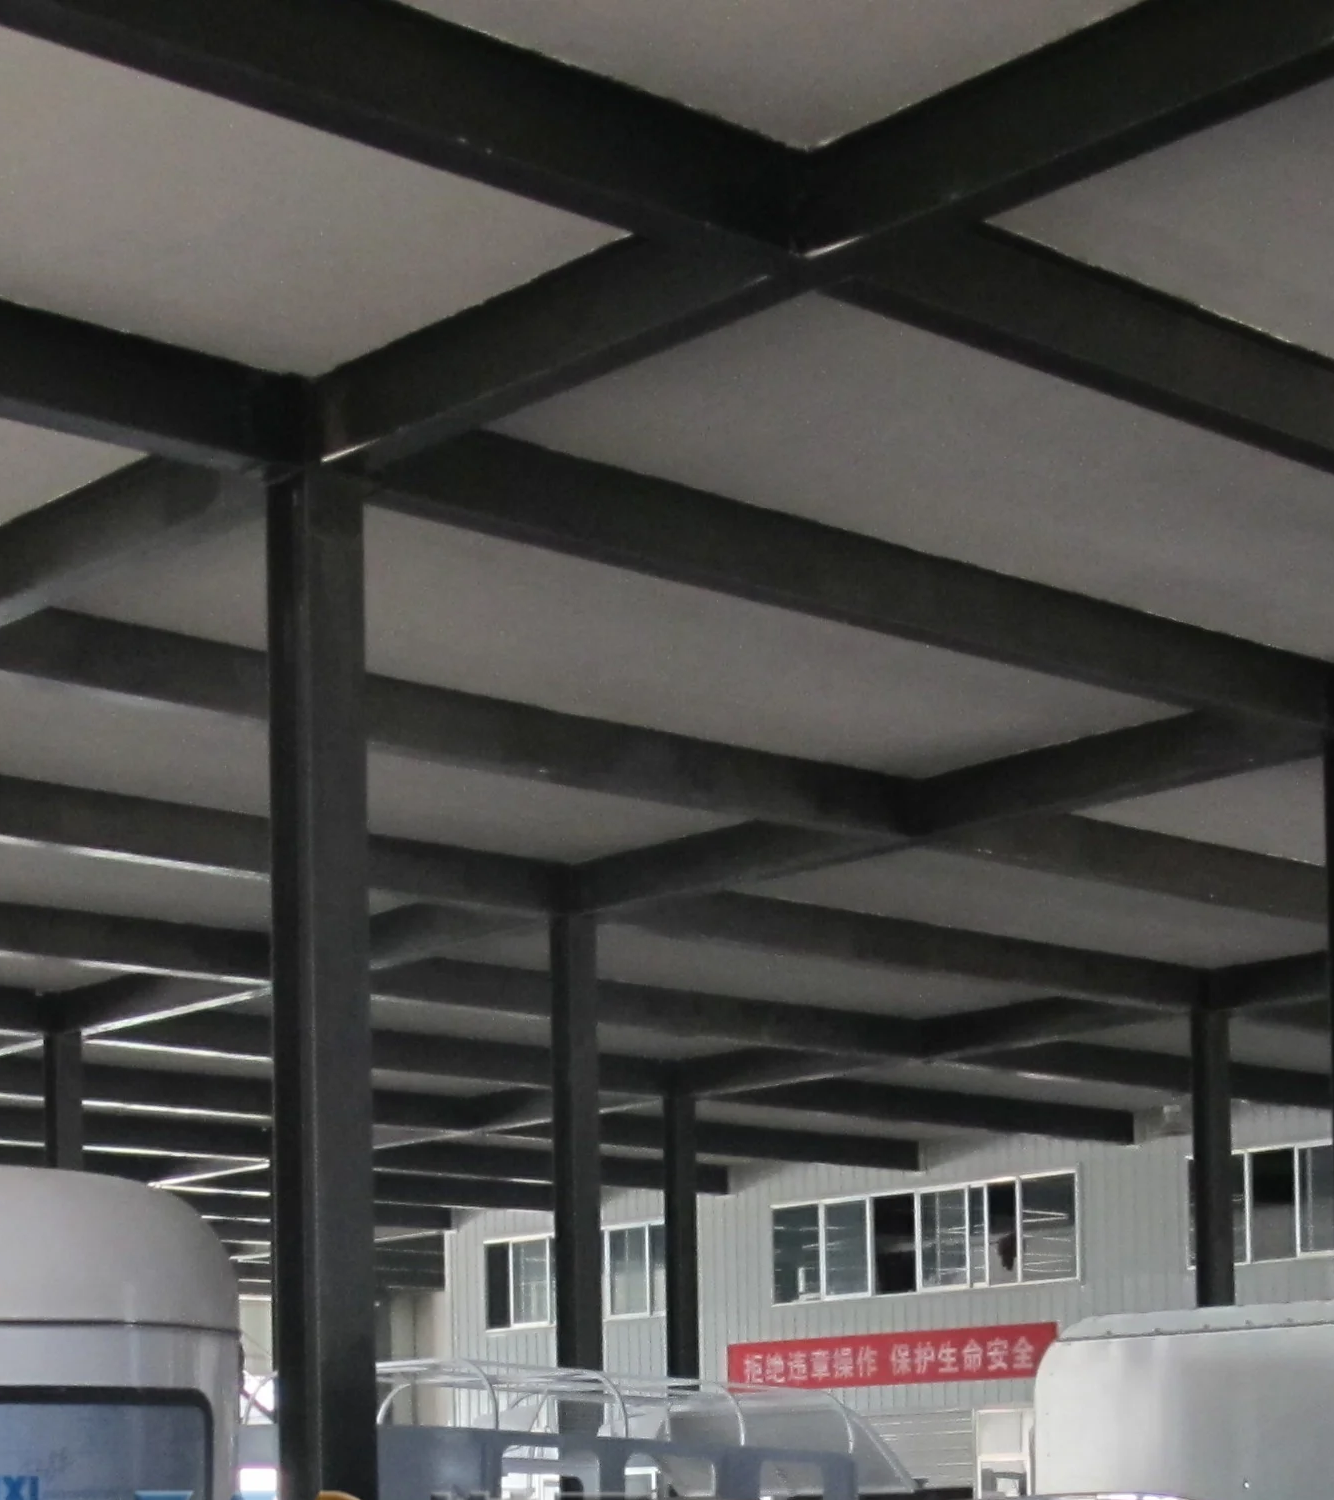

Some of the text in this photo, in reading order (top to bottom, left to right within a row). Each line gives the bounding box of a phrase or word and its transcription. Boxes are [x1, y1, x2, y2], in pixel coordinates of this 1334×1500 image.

[742, 1335, 1035, 1384] 拒绝违章操作 保护生命安全
